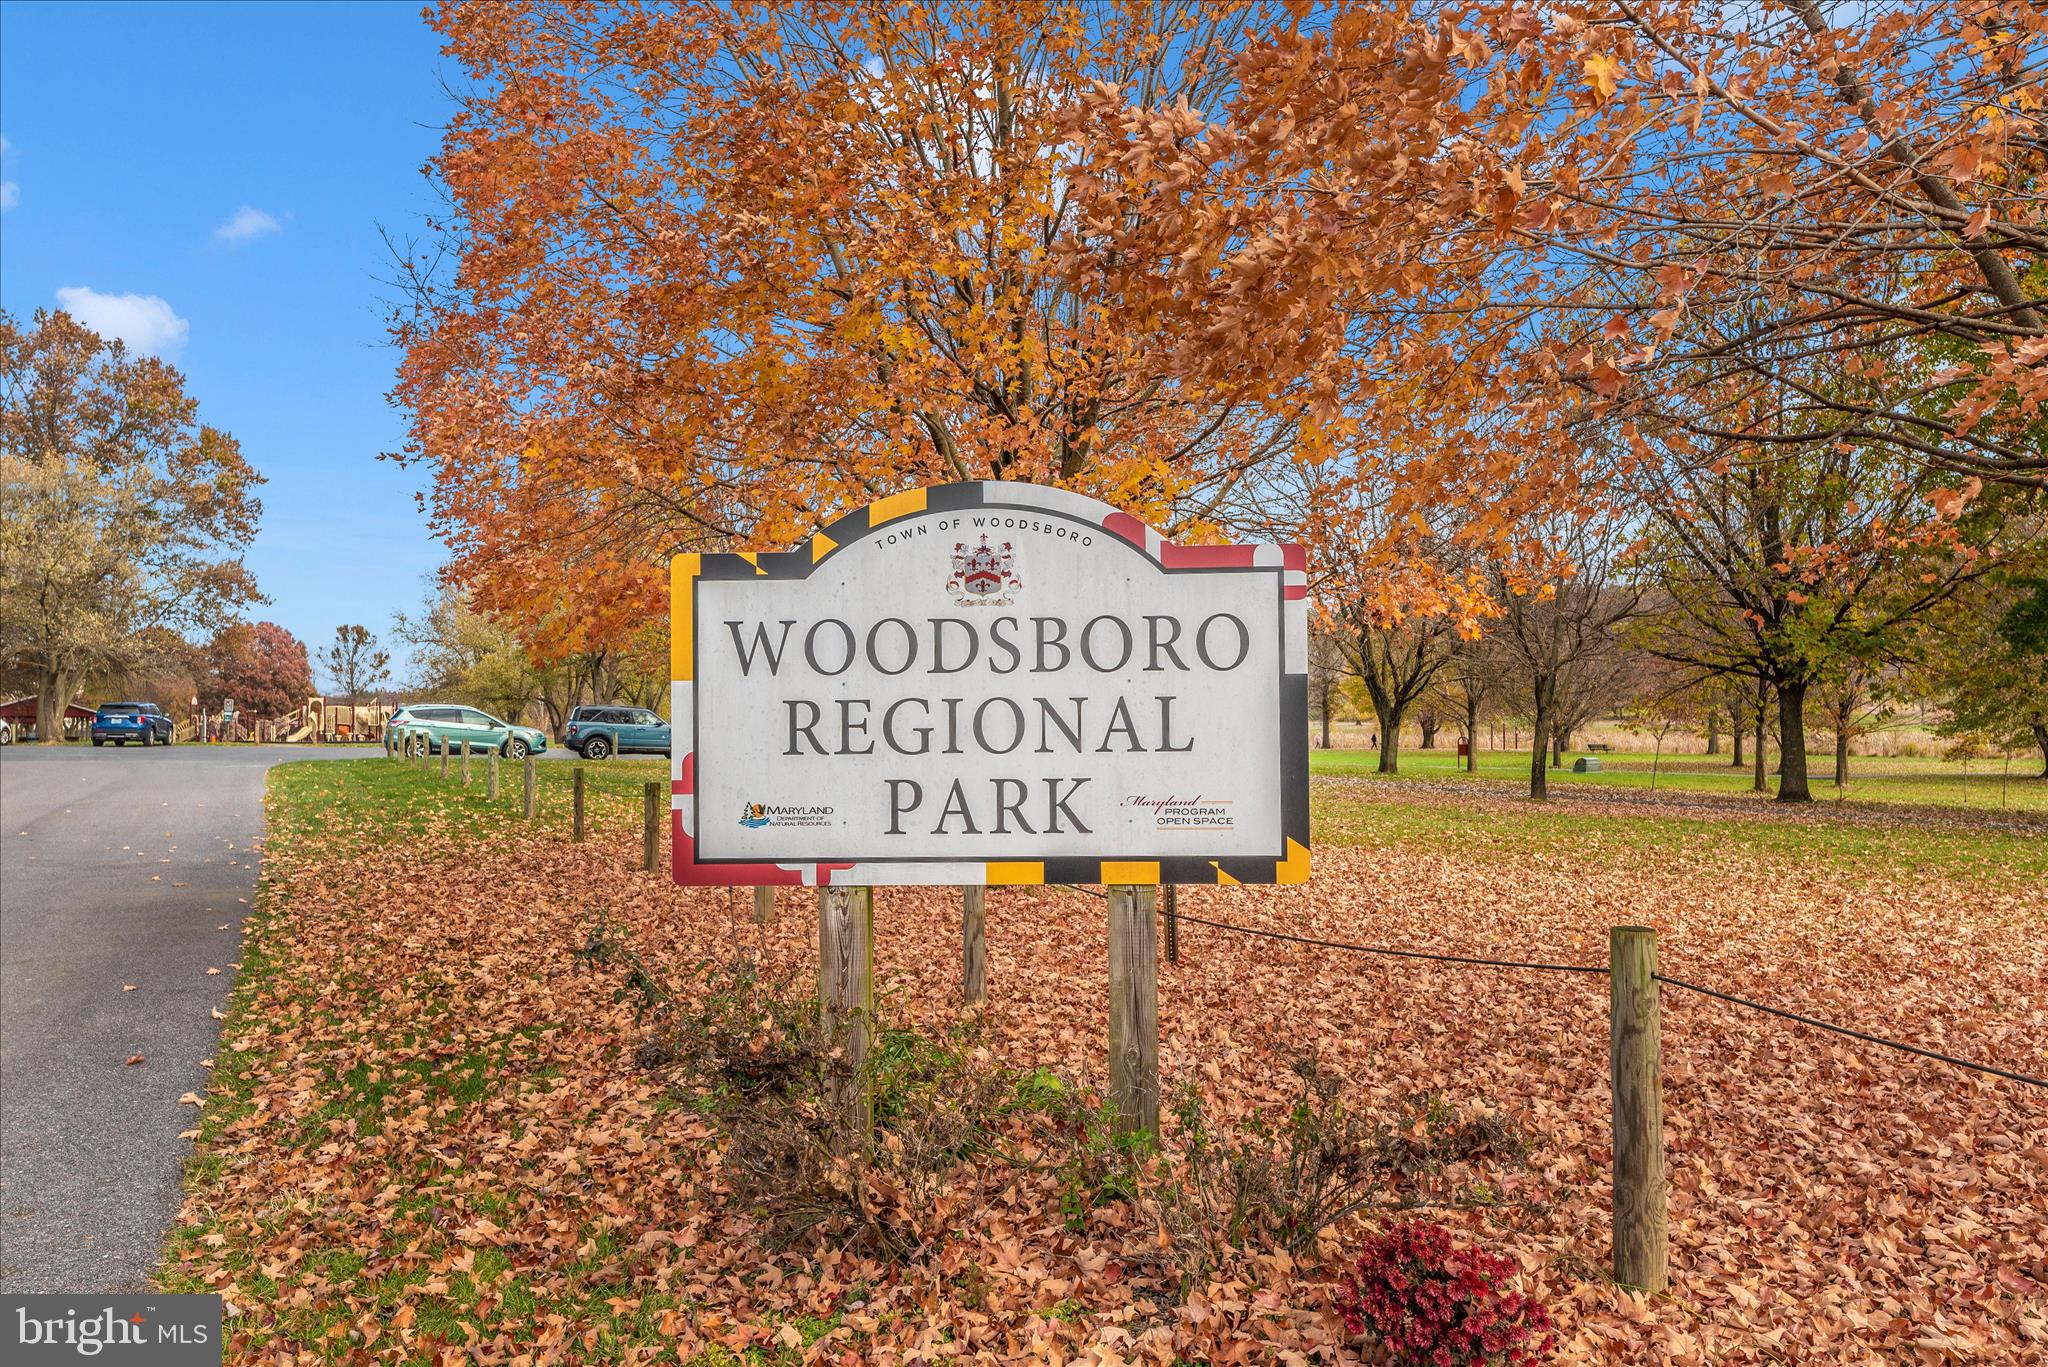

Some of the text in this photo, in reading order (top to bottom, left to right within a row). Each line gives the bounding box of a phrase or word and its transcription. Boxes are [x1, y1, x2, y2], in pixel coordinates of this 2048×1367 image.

[875, 517, 1092, 550] TOWN OF WOODSBORO
[723, 613, 1250, 677] WOODSBORO
[782, 695, 1195, 756] REGIONAL
[767, 806, 834, 815] MARYLAND
[884, 777, 1093, 836] PARK
[1119, 795, 1202, 815] Maryland
[1156, 817, 1234, 825] OPEN SPACE
